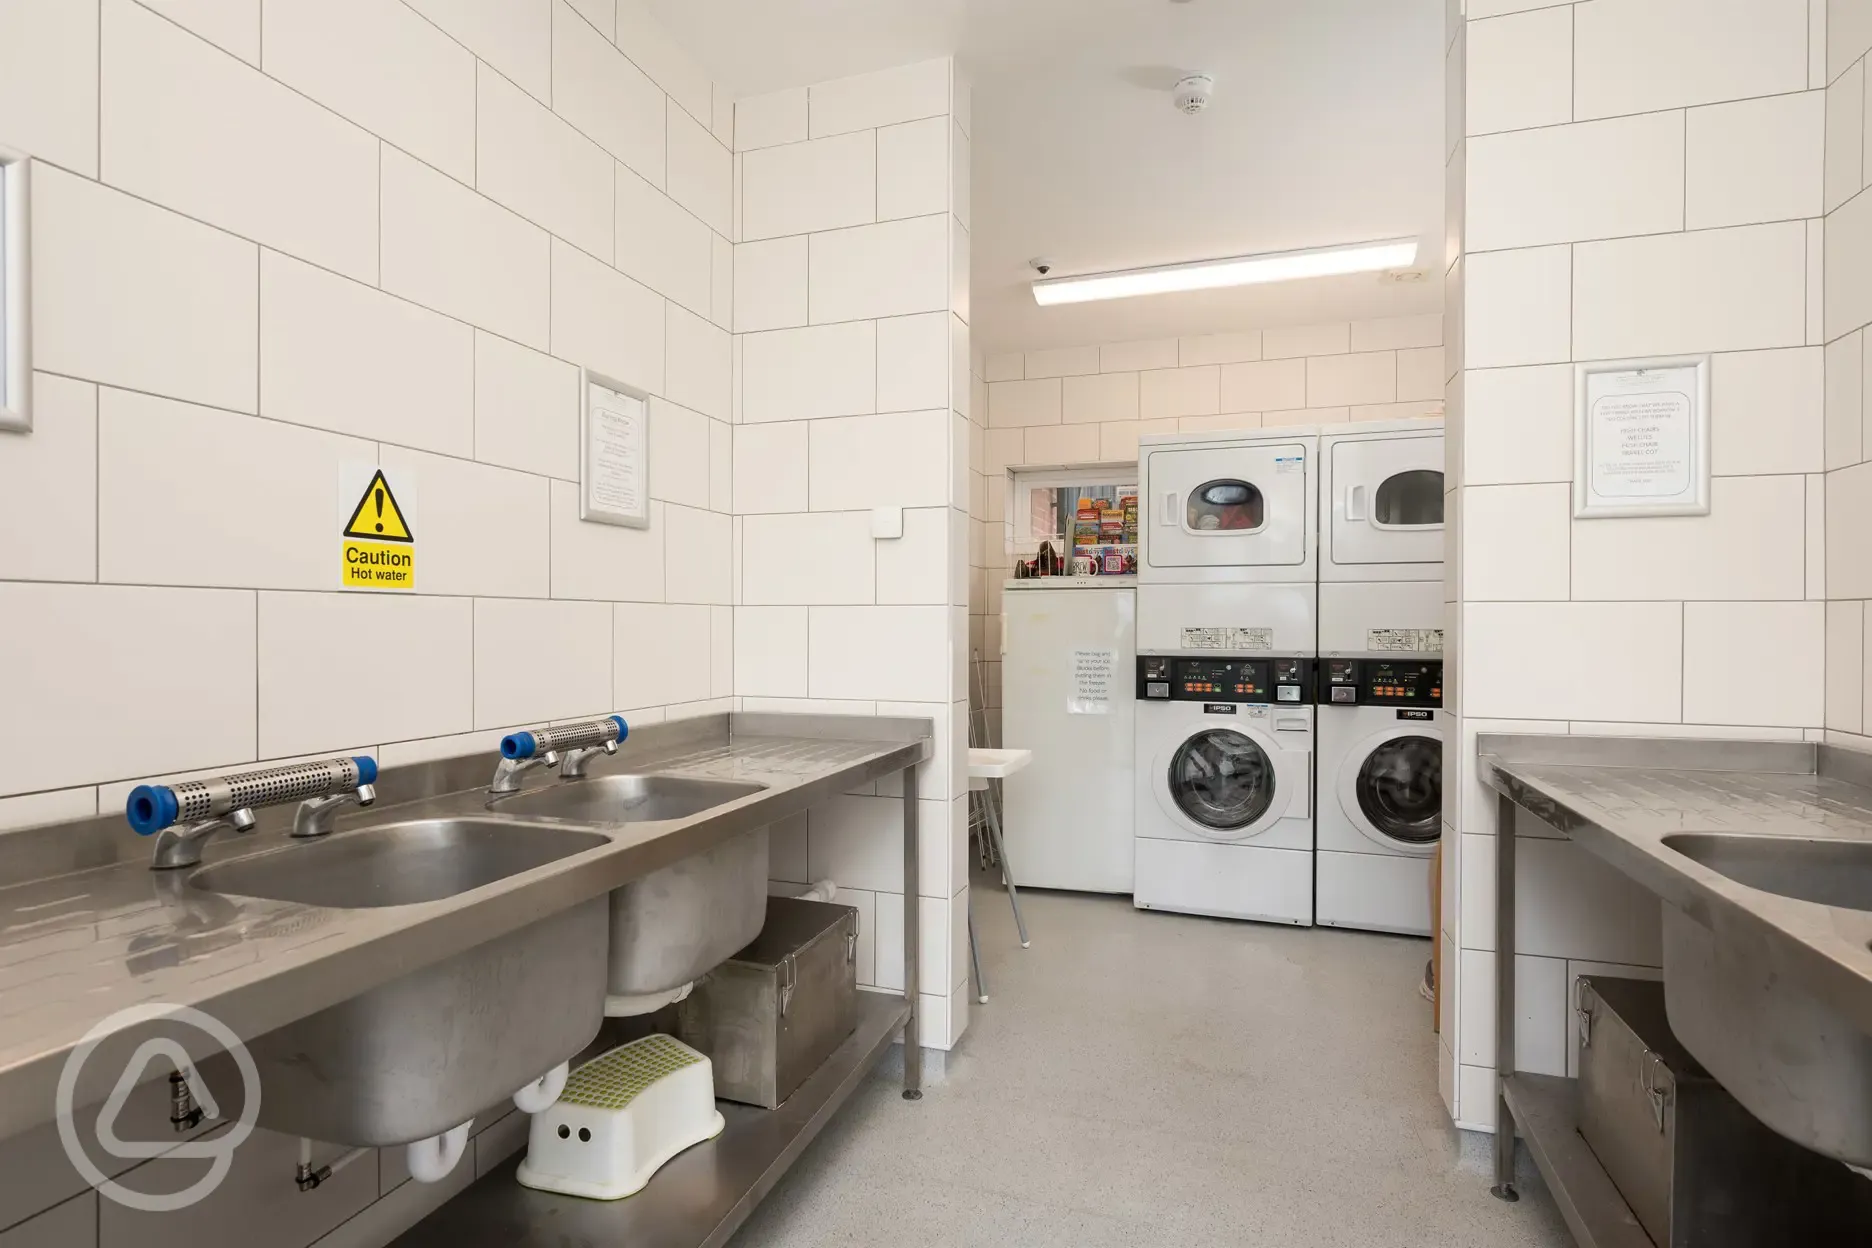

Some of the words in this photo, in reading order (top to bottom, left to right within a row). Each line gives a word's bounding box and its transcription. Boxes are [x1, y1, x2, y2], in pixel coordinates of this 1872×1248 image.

[346, 547, 411, 567] Caution
[351, 567, 372, 579] Hot
[376, 570, 407, 581] water
